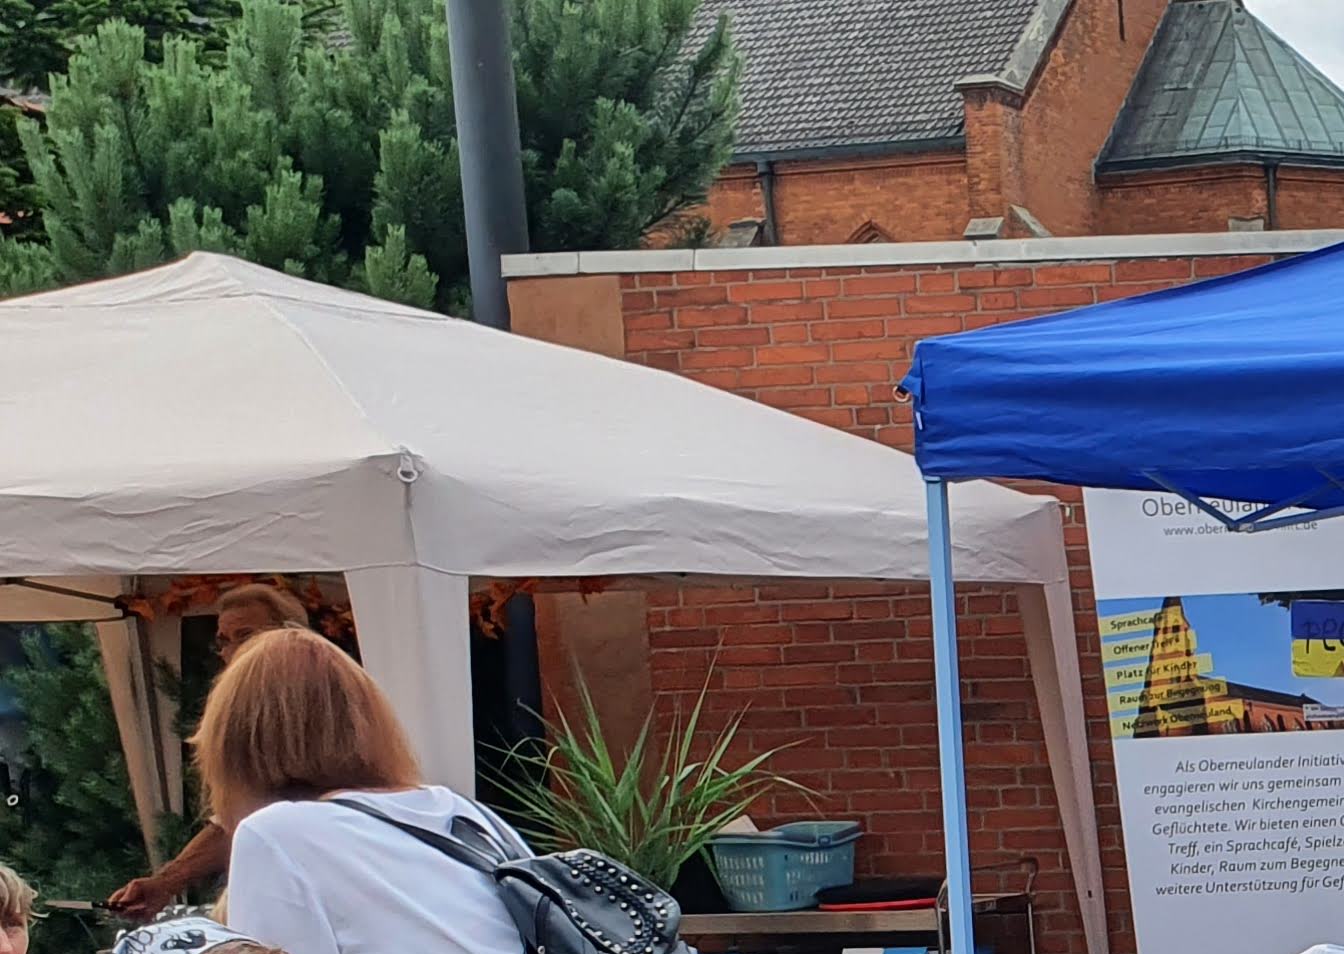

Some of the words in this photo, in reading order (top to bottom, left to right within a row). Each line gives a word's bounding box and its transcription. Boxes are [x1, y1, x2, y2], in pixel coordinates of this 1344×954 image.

[1113, 641, 1149, 655] Offener
[1117, 667, 1144, 680] Platz
[1175, 759, 1196, 773] Als
[1198, 755, 1295, 772] Oberneulander
[1143, 781, 1216, 798] engagieren
[1219, 778, 1239, 792] wir
[1242, 779, 1265, 791] uns
[1267, 775, 1341, 793] gemeinsam
[1154, 799, 1246, 817] evangelischen
[1152, 820, 1231, 838] Geflüchtete.
[1234, 819, 1257, 832] Wir
[1260, 818, 1299, 831] bieten
[1302, 816, 1337, 829] einen
[1168, 841, 1200, 858] Treff,
[1204, 841, 1223, 854] ein
[1226, 836, 1301, 855] Sprachcafé,
[1170, 862, 1215, 877] Kinder,
[1219, 860, 1257, 873] Raum
[1260, 860, 1287, 872] zum
[1156, 882, 1203, 896] weitere
[1205, 879, 1298, 894] Unterstützung
[1299, 876, 1320, 893] für
